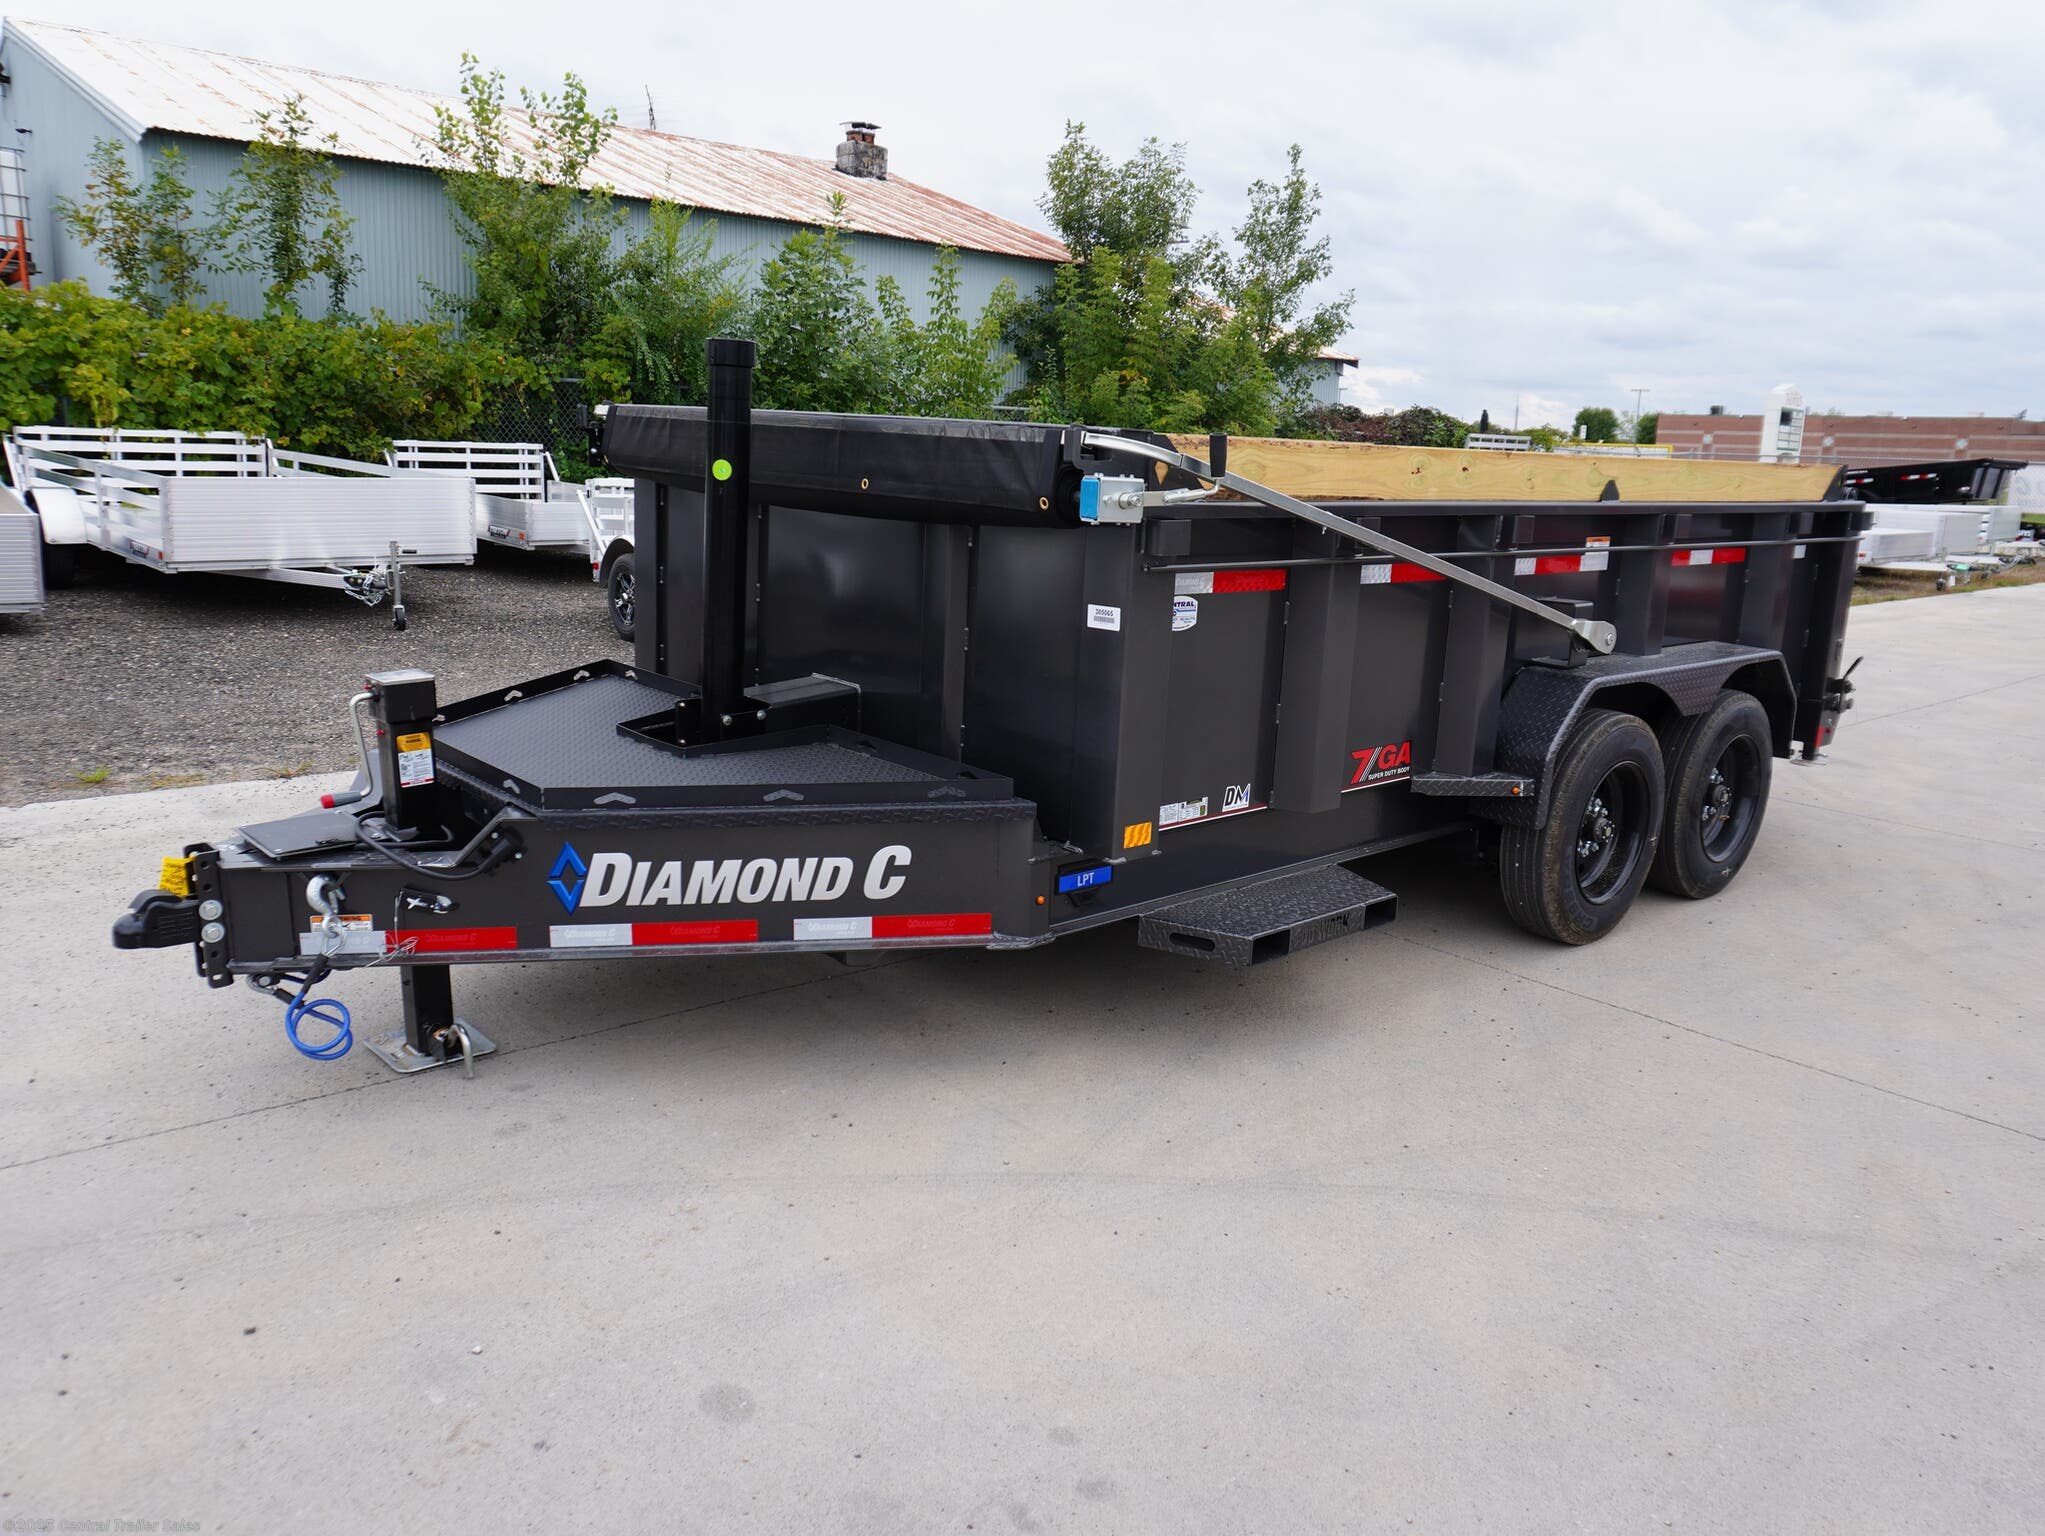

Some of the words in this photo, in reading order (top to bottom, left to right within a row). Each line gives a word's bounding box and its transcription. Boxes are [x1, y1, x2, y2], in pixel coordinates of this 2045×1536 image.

[1368, 771, 1384, 781] SUPER
[1384, 768, 1397, 777] DUTY
[1397, 766, 1410, 774] BODY
[1223, 784, 1250, 807] DM
[579, 852, 854, 907] DIAMOND
[863, 844, 912, 900] C
[1077, 872, 1095, 887] LPT
